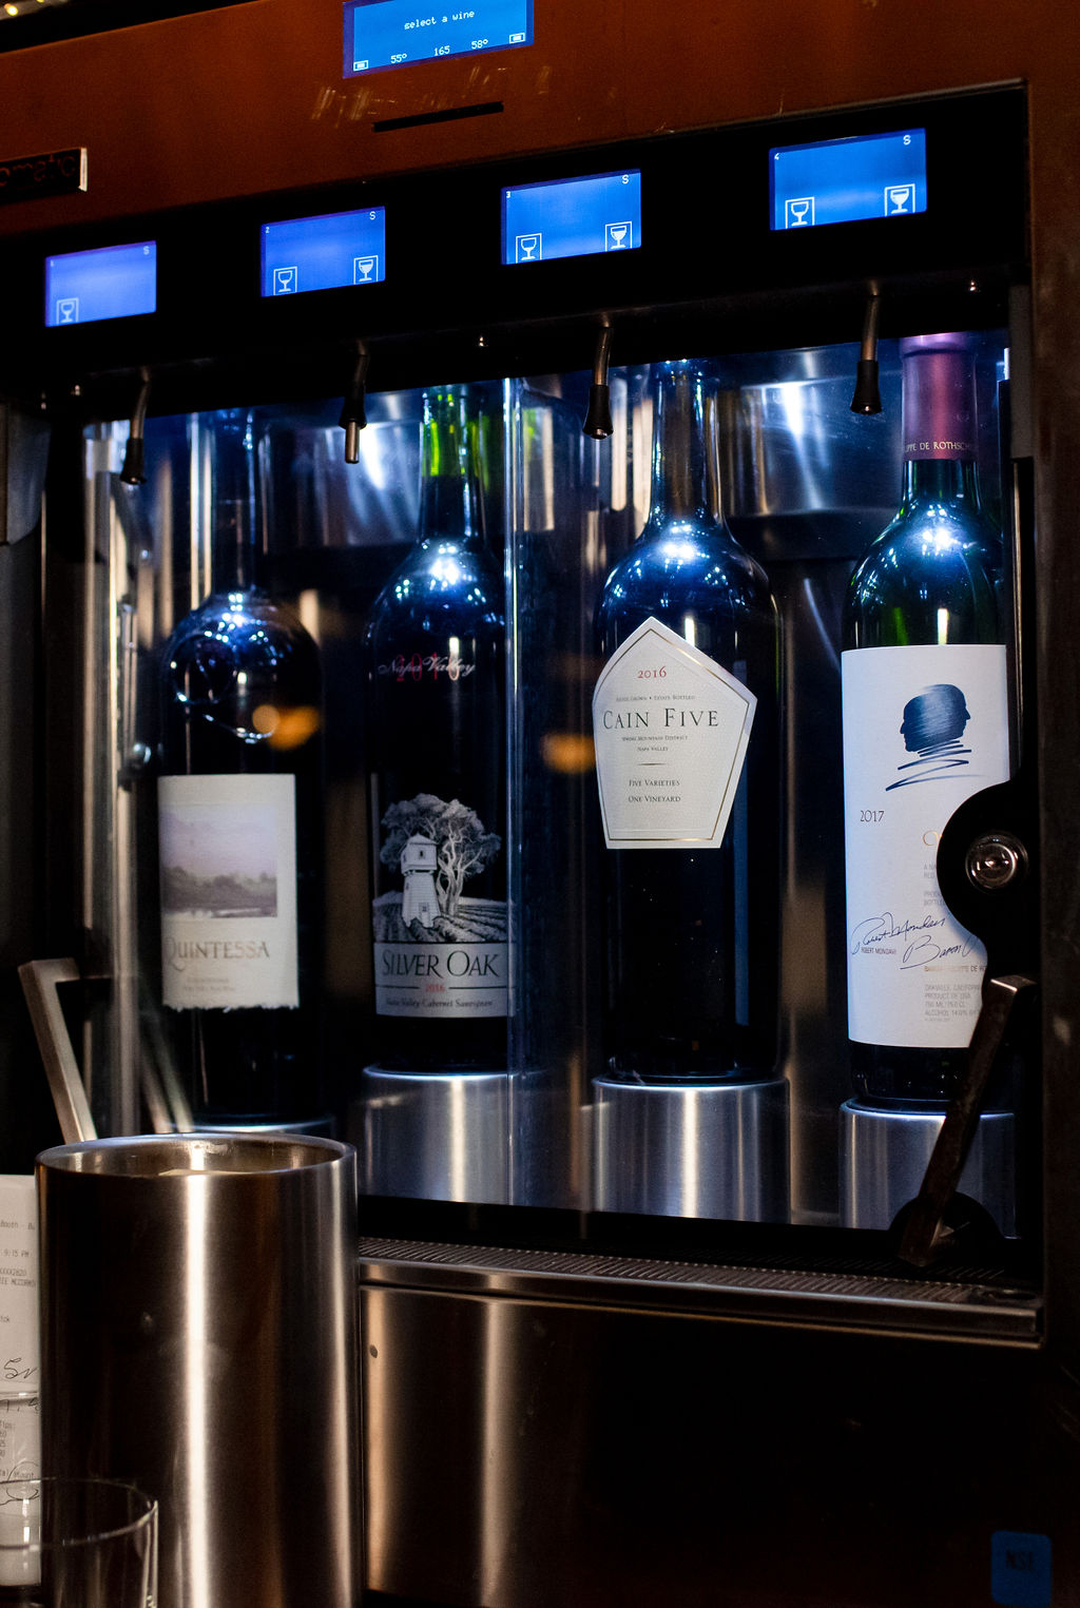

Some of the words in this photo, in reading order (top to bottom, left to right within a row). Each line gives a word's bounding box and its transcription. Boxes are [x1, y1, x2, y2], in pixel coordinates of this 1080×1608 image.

[404, 17, 437, 30] select
[452, 10, 475, 21] wine
[434, 45, 450, 56] 165
[903, 134, 911, 145] S
[622, 174, 629, 184] S
[369, 211, 376, 220] S
[143, 245, 150, 255] S
[919, 442, 930, 450] DE
[637, 665, 667, 679] 2016
[602, 710, 649, 730] CAIN
[664, 707, 719, 728] FIVE
[644, 795, 681, 803] VINEYARD
[860, 809, 885, 822] 2017
[382, 950, 444, 978] SILVER
[447, 951, 499, 978] OAK
